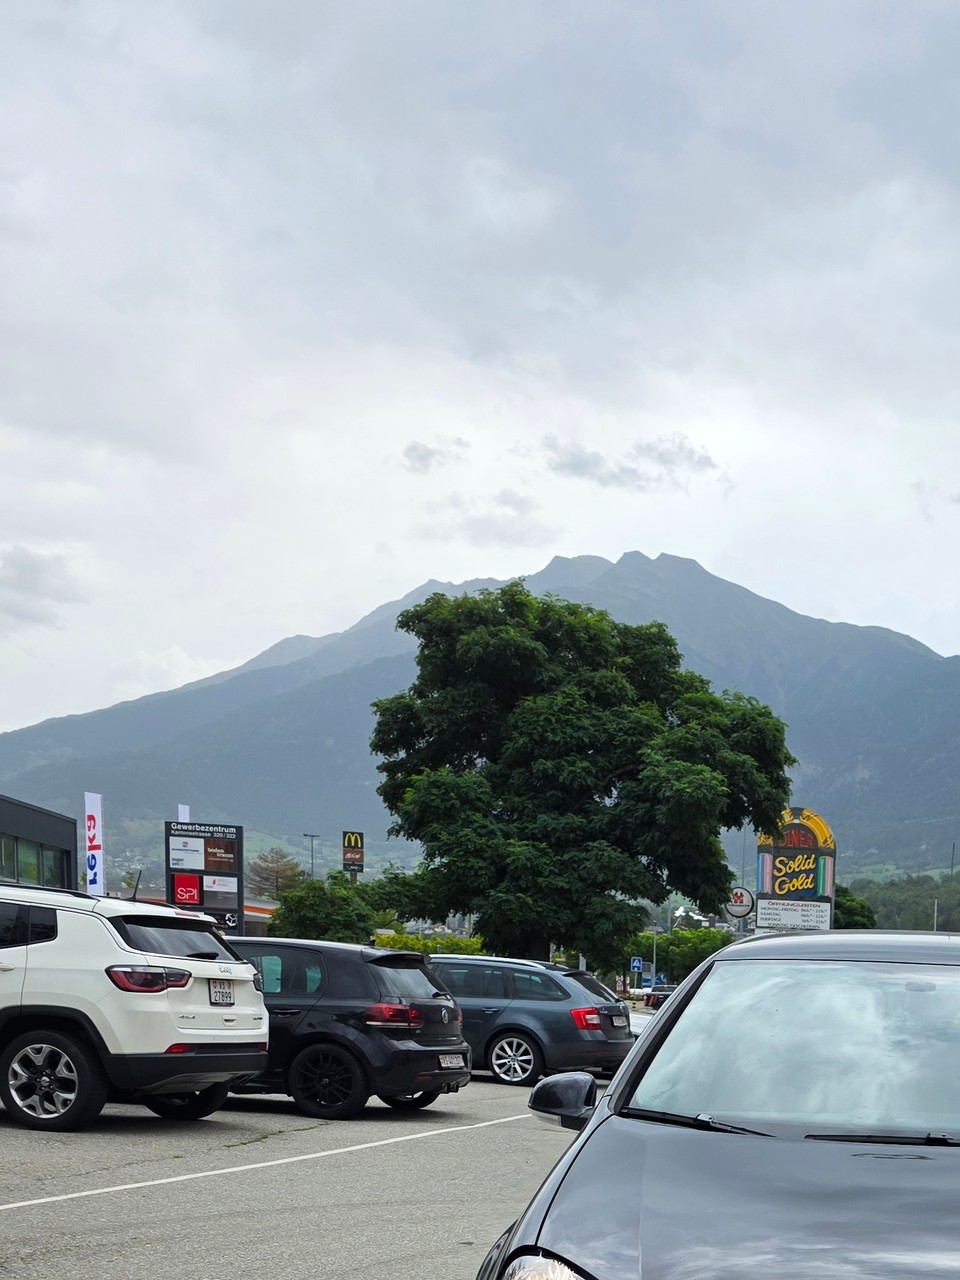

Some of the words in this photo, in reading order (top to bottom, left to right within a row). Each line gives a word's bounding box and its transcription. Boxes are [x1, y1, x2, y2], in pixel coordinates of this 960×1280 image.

[171, 823, 236, 833] Gewerbezentrum
[773, 853, 816, 877] Solid
[774, 873, 815, 895] Gold
[177, 887, 198, 900] SPI
